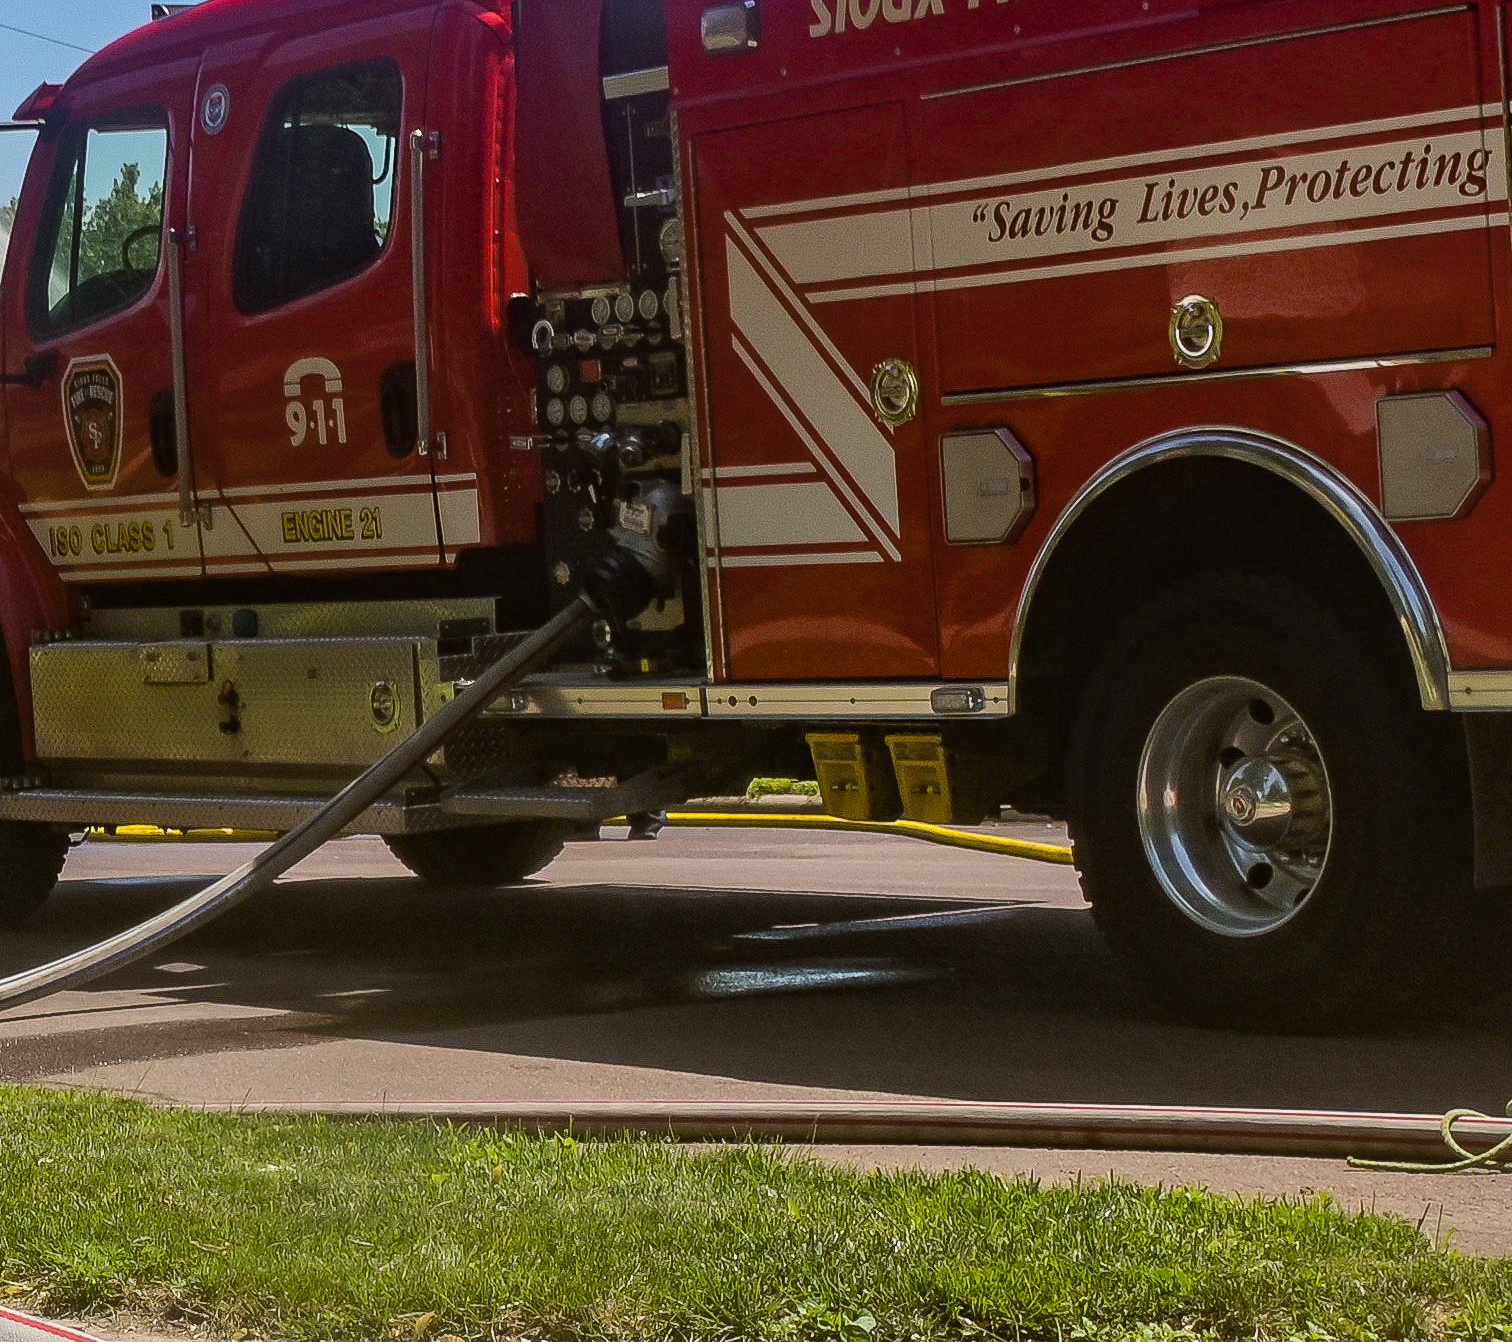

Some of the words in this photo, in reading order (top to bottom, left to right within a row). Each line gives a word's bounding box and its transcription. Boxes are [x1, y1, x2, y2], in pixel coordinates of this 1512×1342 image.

[49, 526, 82, 556] ISO
[91, 520, 154, 554] CLASS
[163, 520, 174, 549] 1
[282, 508, 354, 543] ENGINE
[359, 505, 382, 540] 21
